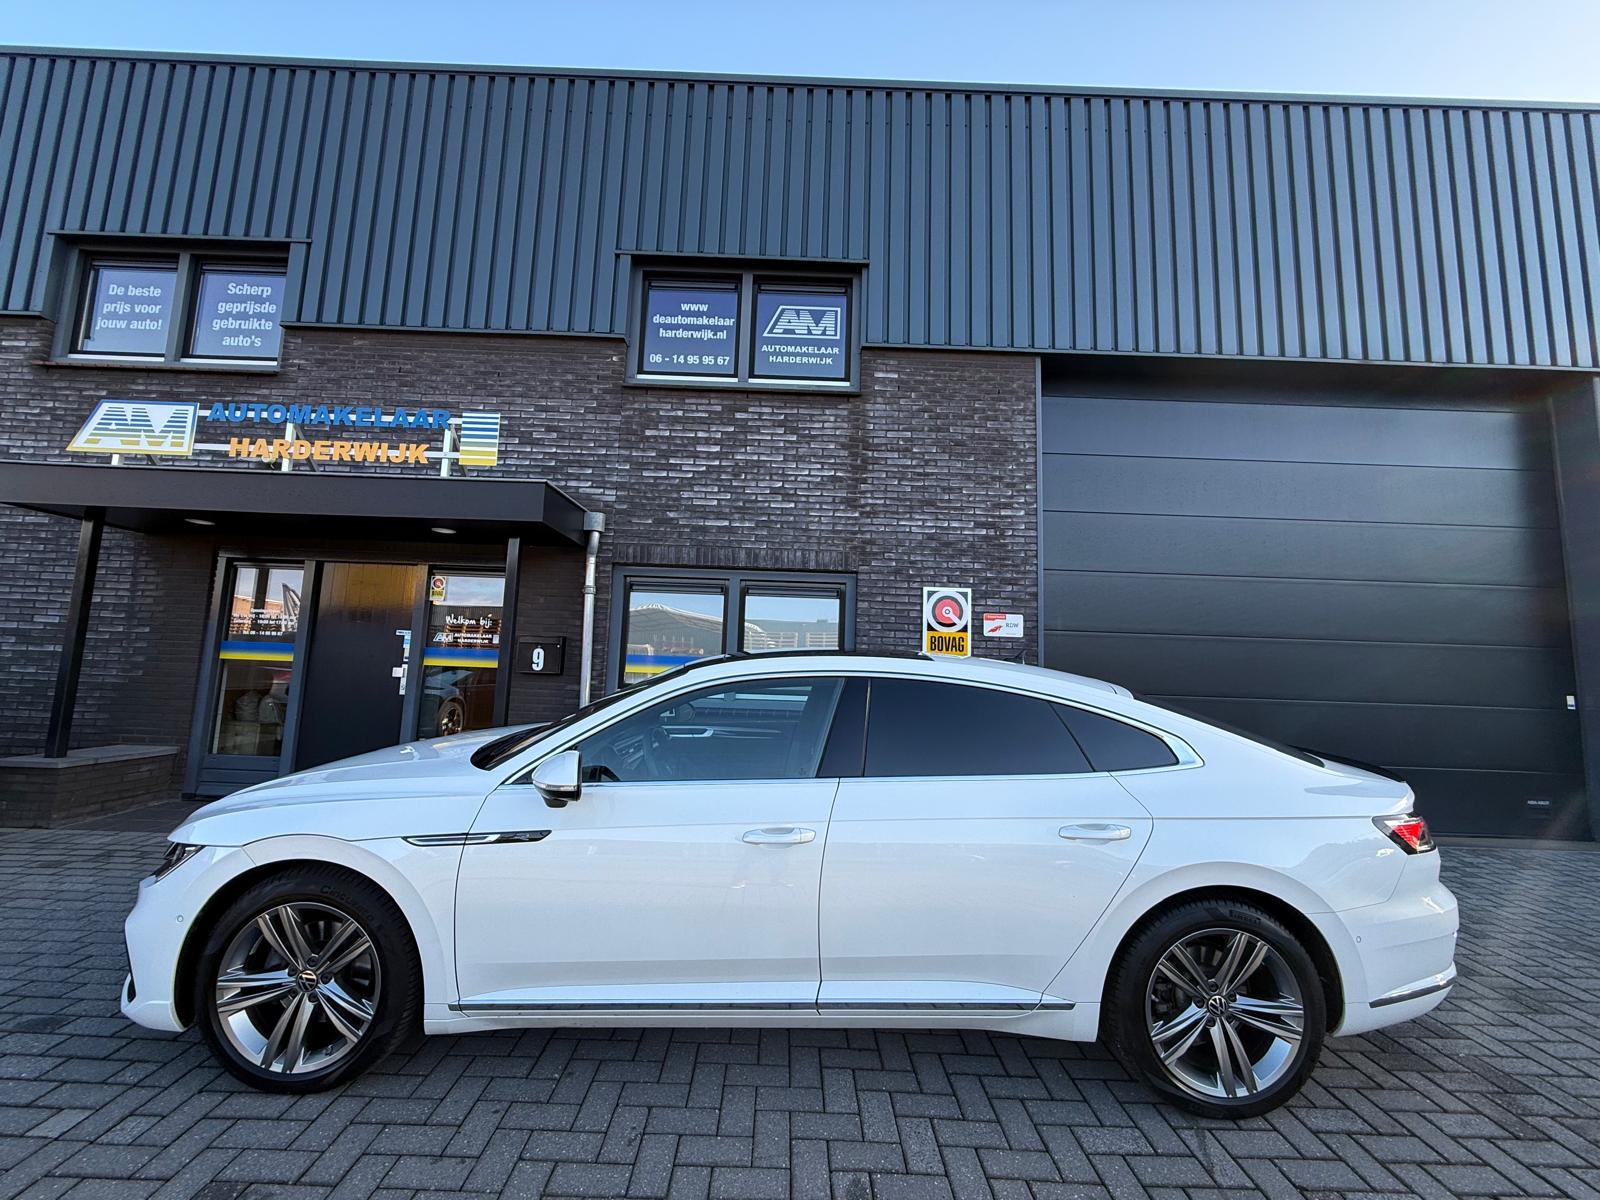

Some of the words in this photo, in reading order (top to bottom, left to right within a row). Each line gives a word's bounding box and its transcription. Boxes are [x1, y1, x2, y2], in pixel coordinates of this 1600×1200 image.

[108, 284, 125, 296] De
[127, 285, 161, 297] beste
[227, 282, 272, 298] Scherp
[103, 302, 131, 315] prijs
[134, 304, 161, 314] voor
[217, 301, 276, 315] geprijsde
[681, 303, 708, 312] www
[96, 317, 127, 330] jouw
[130, 319, 162, 330] auto!
[212, 317, 273, 331] gebruikte
[653, 314, 735, 326] deautomakelaar
[659, 328, 727, 340] harderwijk.nl
[222, 335, 262, 347] auto's
[761, 344, 839, 354] AUTOMAKELAAR
[649, 353, 663, 363] 06
[672, 354, 685, 364] 14
[687, 355, 700, 364] 95
[702, 355, 715, 365] 95
[717, 356, 730, 365] 67
[769, 355, 833, 365] HARDERWIJK
[206, 402, 452, 430] AUTOMAKELAAR
[228, 437, 430, 464] HARDERWIJK
[445, 614, 476, 626] Welkom
[930, 636, 964, 652] BOVAG
[532, 648, 545, 671] 9
